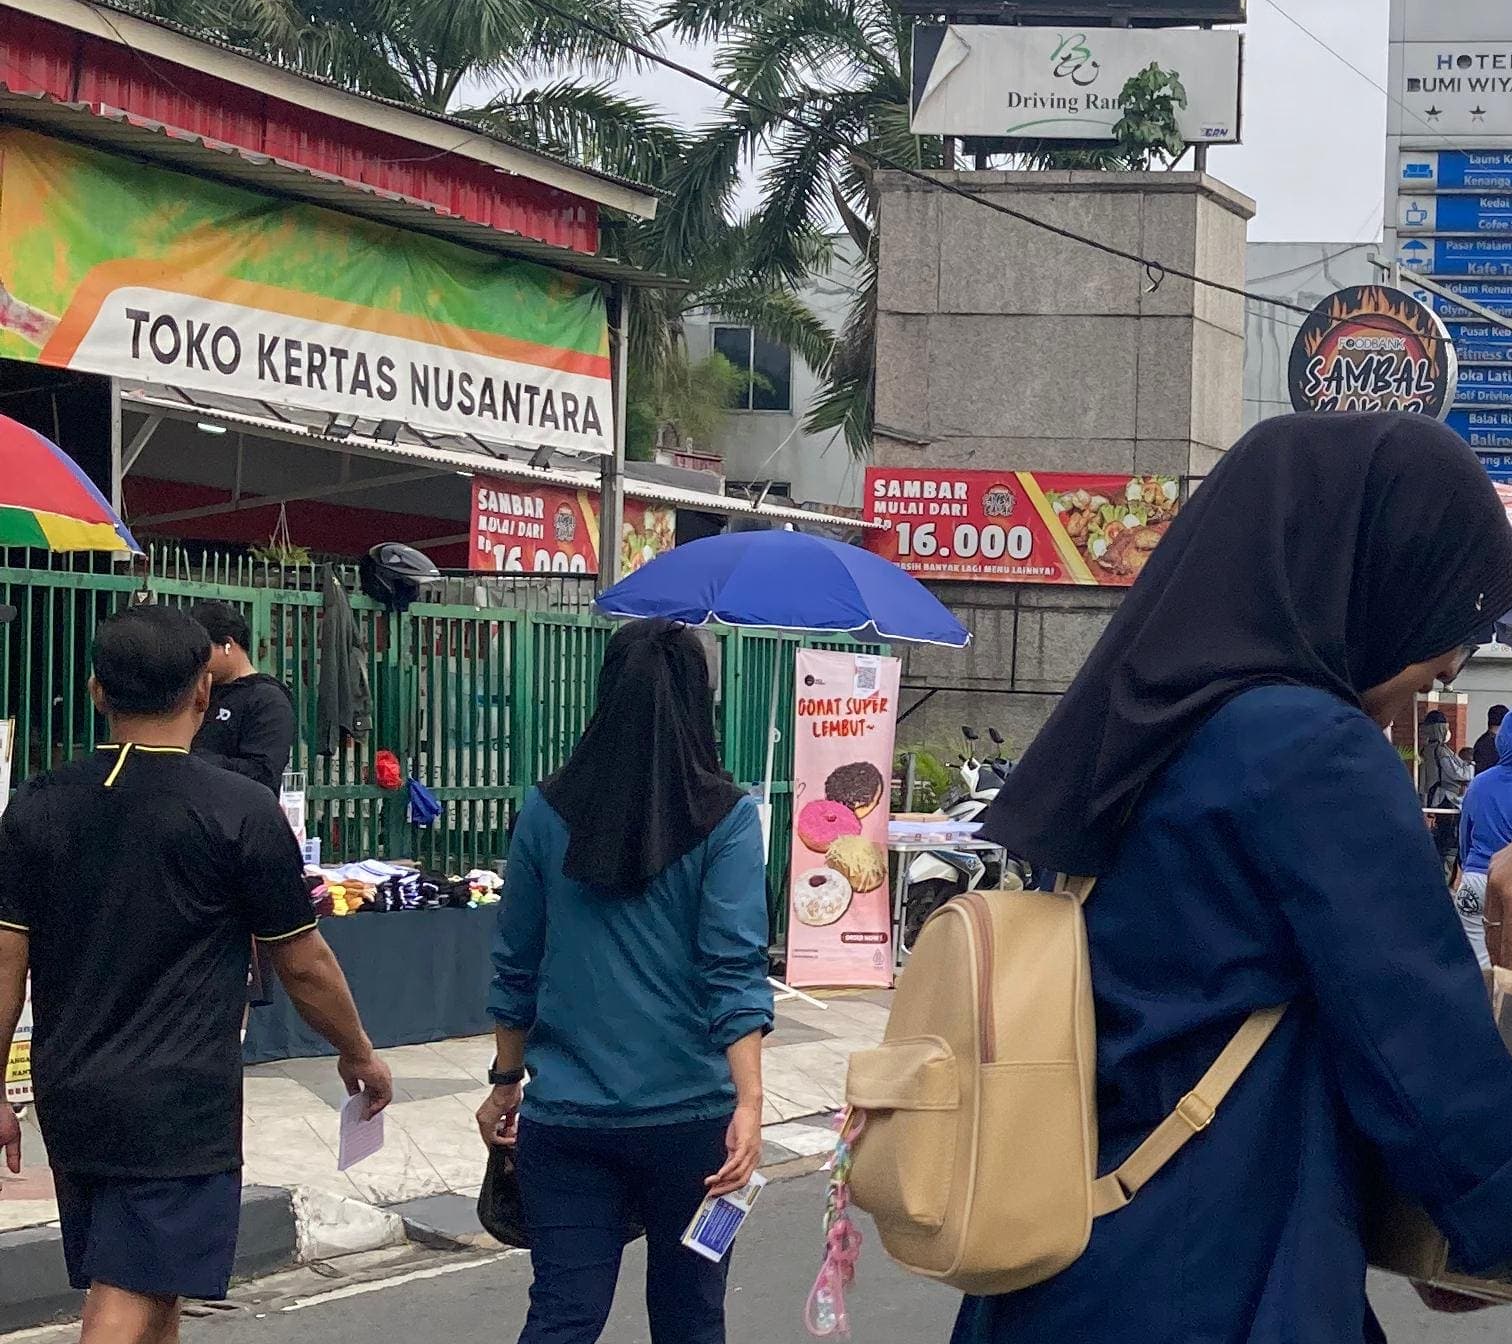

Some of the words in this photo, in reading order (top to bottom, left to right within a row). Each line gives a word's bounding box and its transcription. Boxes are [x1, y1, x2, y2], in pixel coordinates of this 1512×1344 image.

[1406, 77, 1461, 93] BUMI
[1008, 91, 1079, 113] Driving
[1464, 175, 1511, 188] Kenanga
[1479, 197, 1510, 208] Kedai
[1446, 240, 1473, 251] Pasar
[1467, 263, 1498, 275] Kafe
[1338, 336, 1407, 350] FOODBANK
[125, 307, 242, 376] TOKO
[257, 333, 398, 402] KERTAS
[410, 361, 604, 437] NUSANTARA
[1305, 353, 1435, 397] SAMBAL
[1457, 370, 1484, 382] oka
[1468, 413, 1498, 425] Balai
[874, 479, 968, 500] SAMBAR
[478, 488, 544, 519] SAMBAR
[874, 501, 924, 516] MULAI
[929, 502, 968, 517] DARI
[518, 522, 544, 539] DARI
[896, 522, 1033, 560] 16.000
[923, 563, 960, 572] BANYAK
[961, 564, 982, 573] LAGI
[984, 565, 1010, 574] MENU
[845, 697, 888, 715] SUPER
